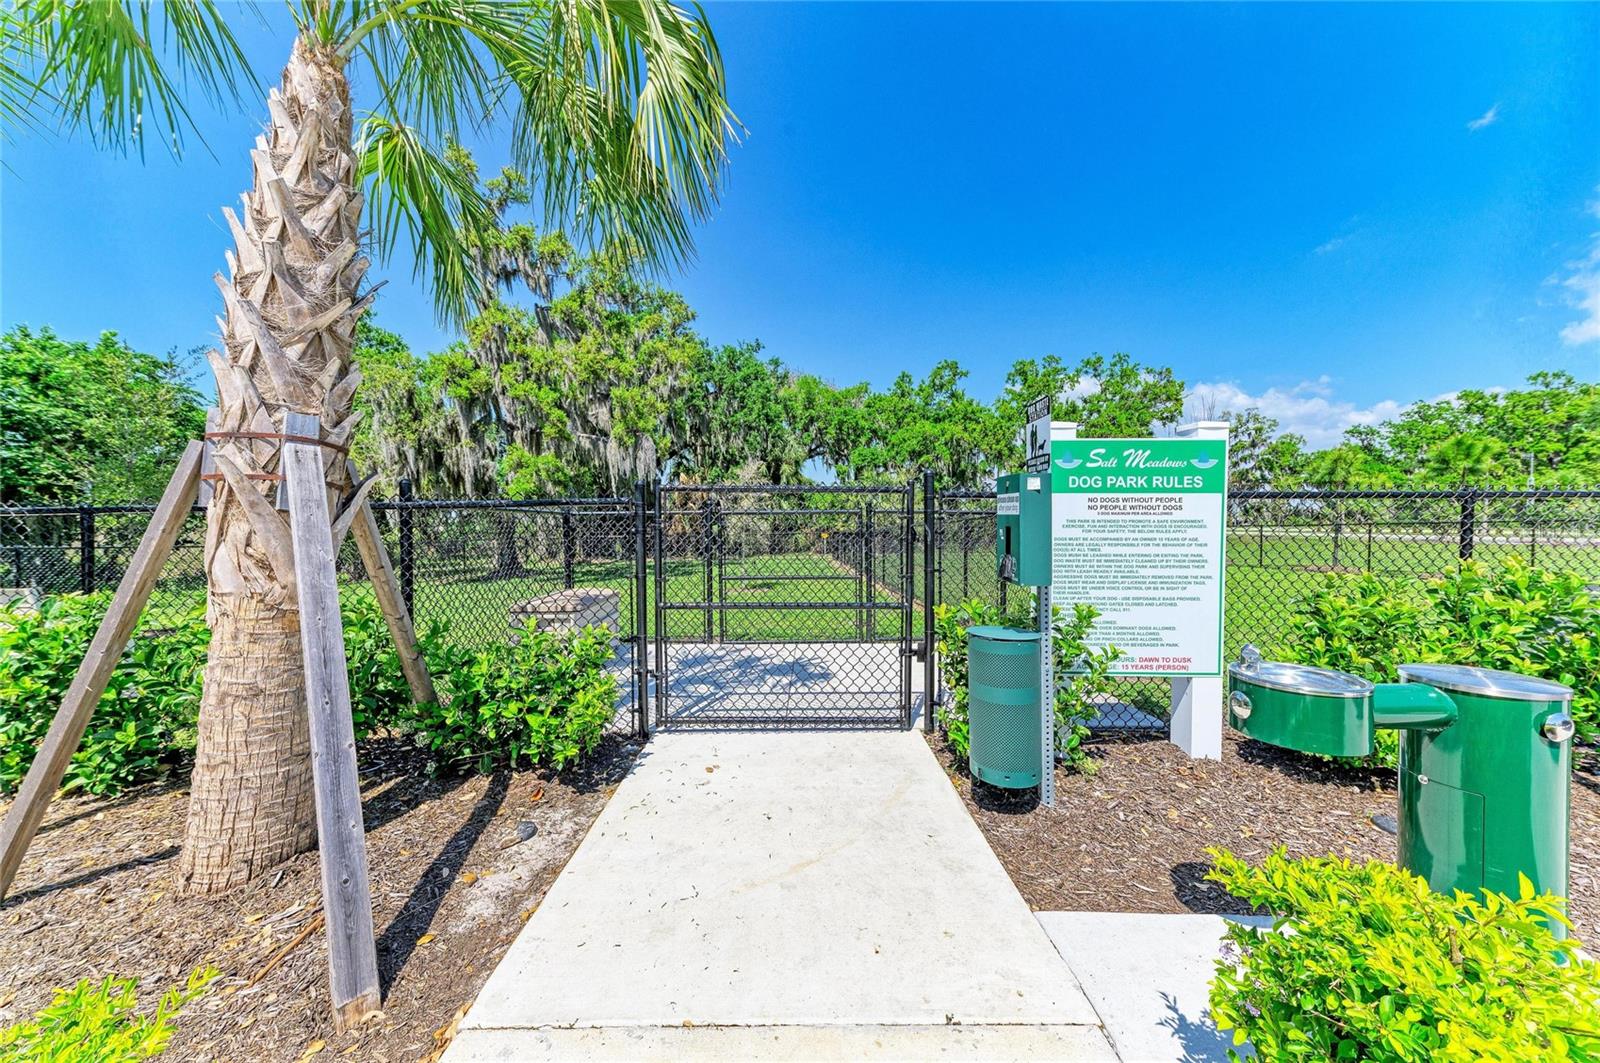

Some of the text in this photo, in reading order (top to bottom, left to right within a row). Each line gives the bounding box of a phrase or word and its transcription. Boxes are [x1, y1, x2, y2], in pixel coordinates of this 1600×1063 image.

[1086, 448, 1188, 468] Salt Meadows
[1068, 476, 1203, 488] DOG PARK RULES
